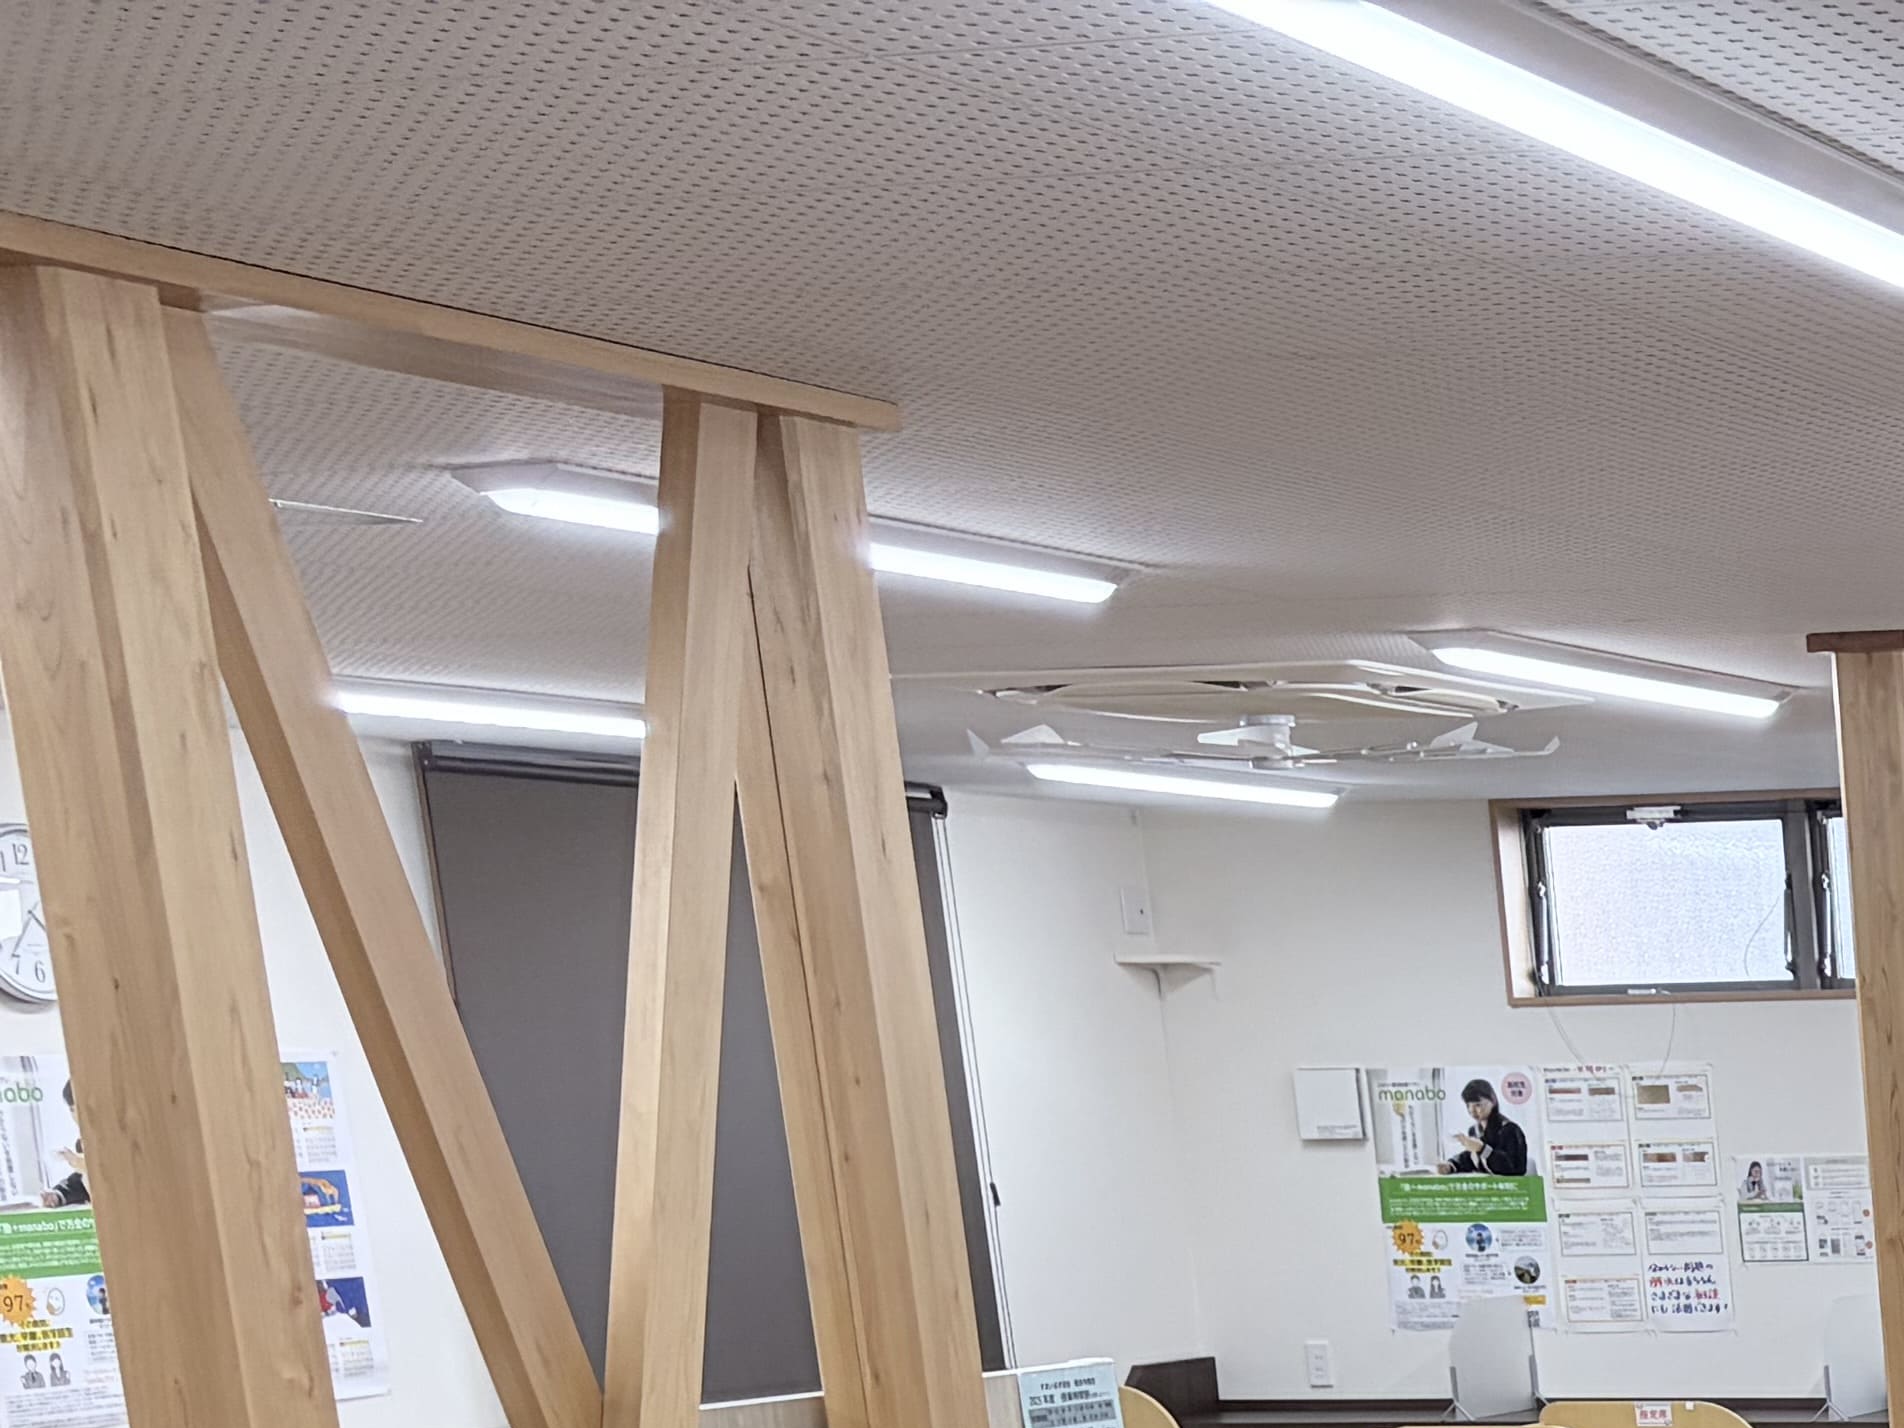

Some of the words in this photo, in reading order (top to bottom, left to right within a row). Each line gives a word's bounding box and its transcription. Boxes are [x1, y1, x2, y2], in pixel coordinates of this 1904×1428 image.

[13, 843, 29, 865] 12
[11, 953, 20, 975] 7
[35, 960, 46, 983] 6
[1379, 1085, 1446, 1101] manabo
[4, 1295, 24, 1312] 97
[1639, 1407, 1669, 1422] 指定席
